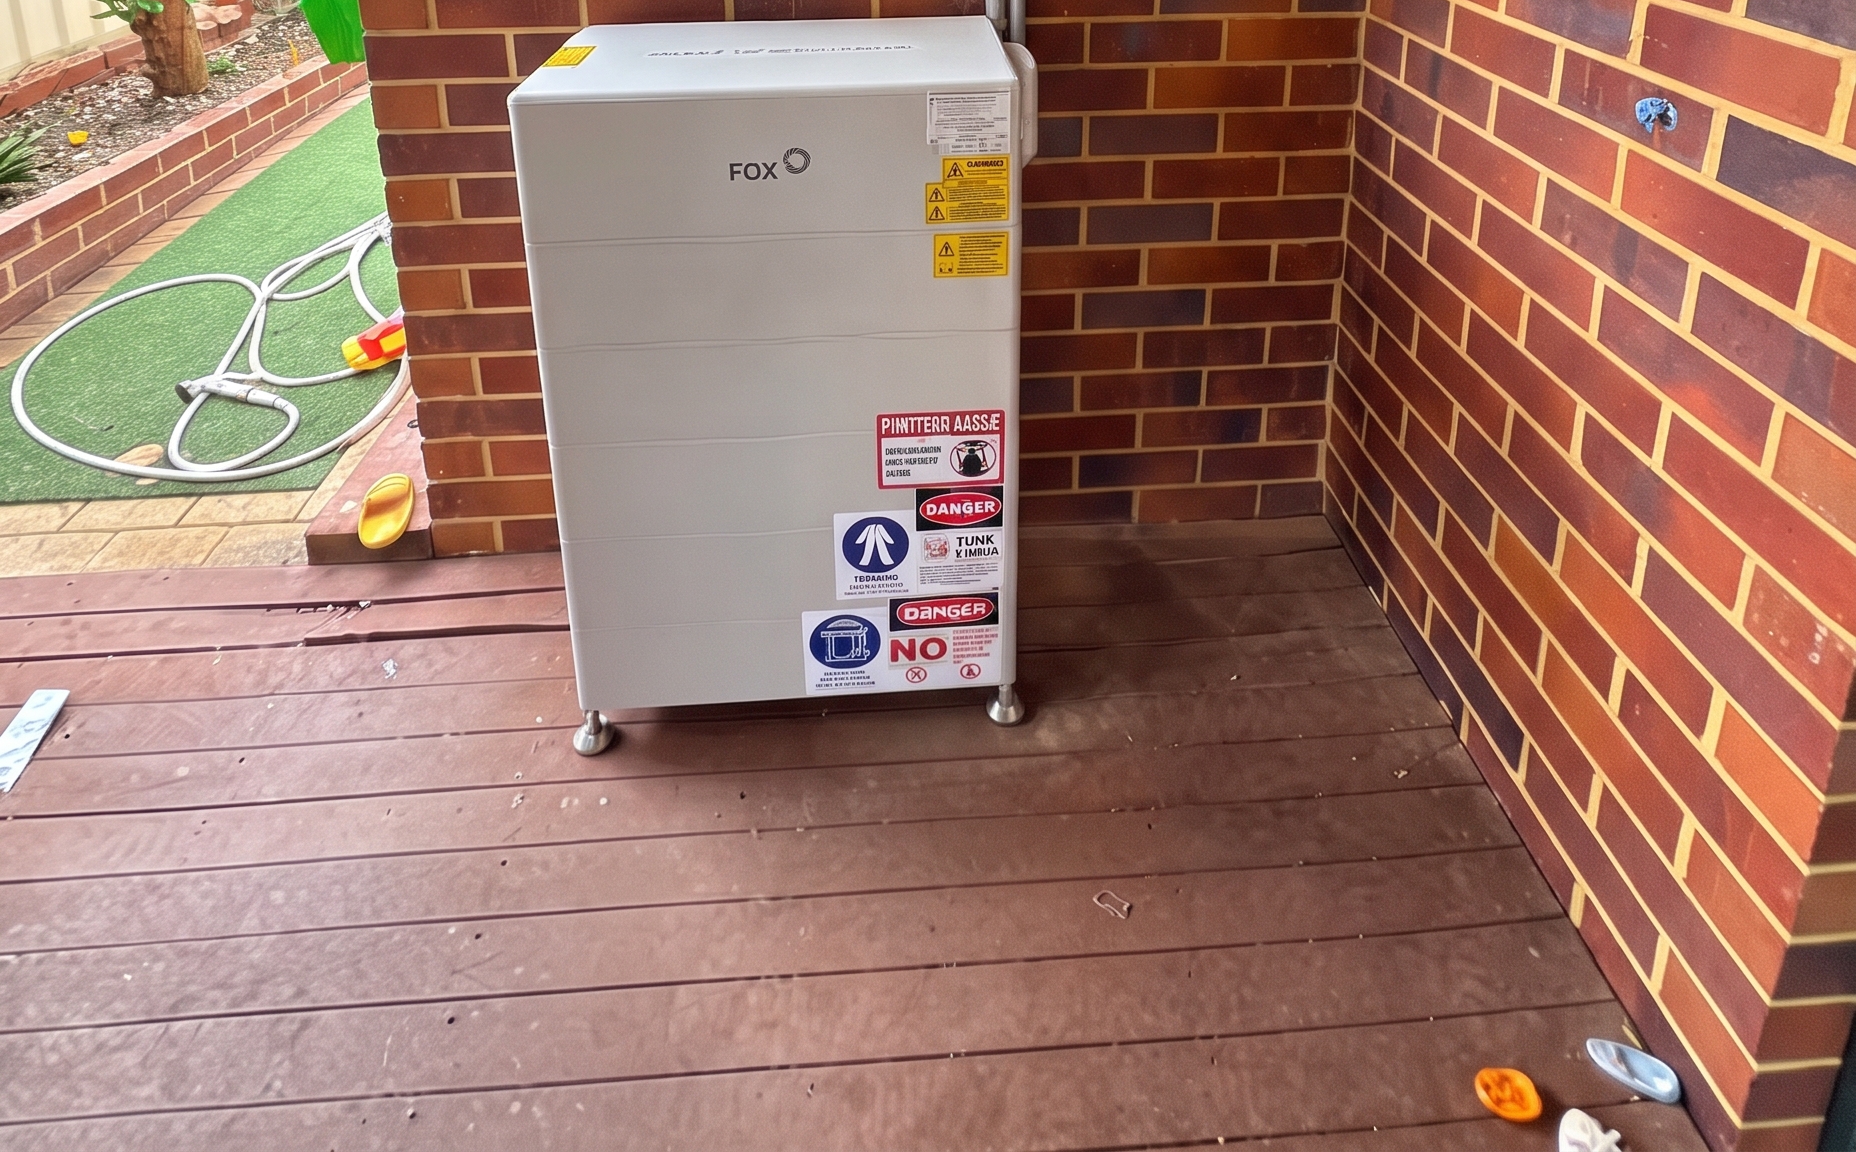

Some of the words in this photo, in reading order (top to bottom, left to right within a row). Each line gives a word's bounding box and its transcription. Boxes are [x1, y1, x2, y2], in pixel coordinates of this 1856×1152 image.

[729, 162, 778, 181] FOX
[926, 501, 996, 516] DANGER
[956, 534, 995, 547] TUNK
[890, 637, 948, 663] NO
